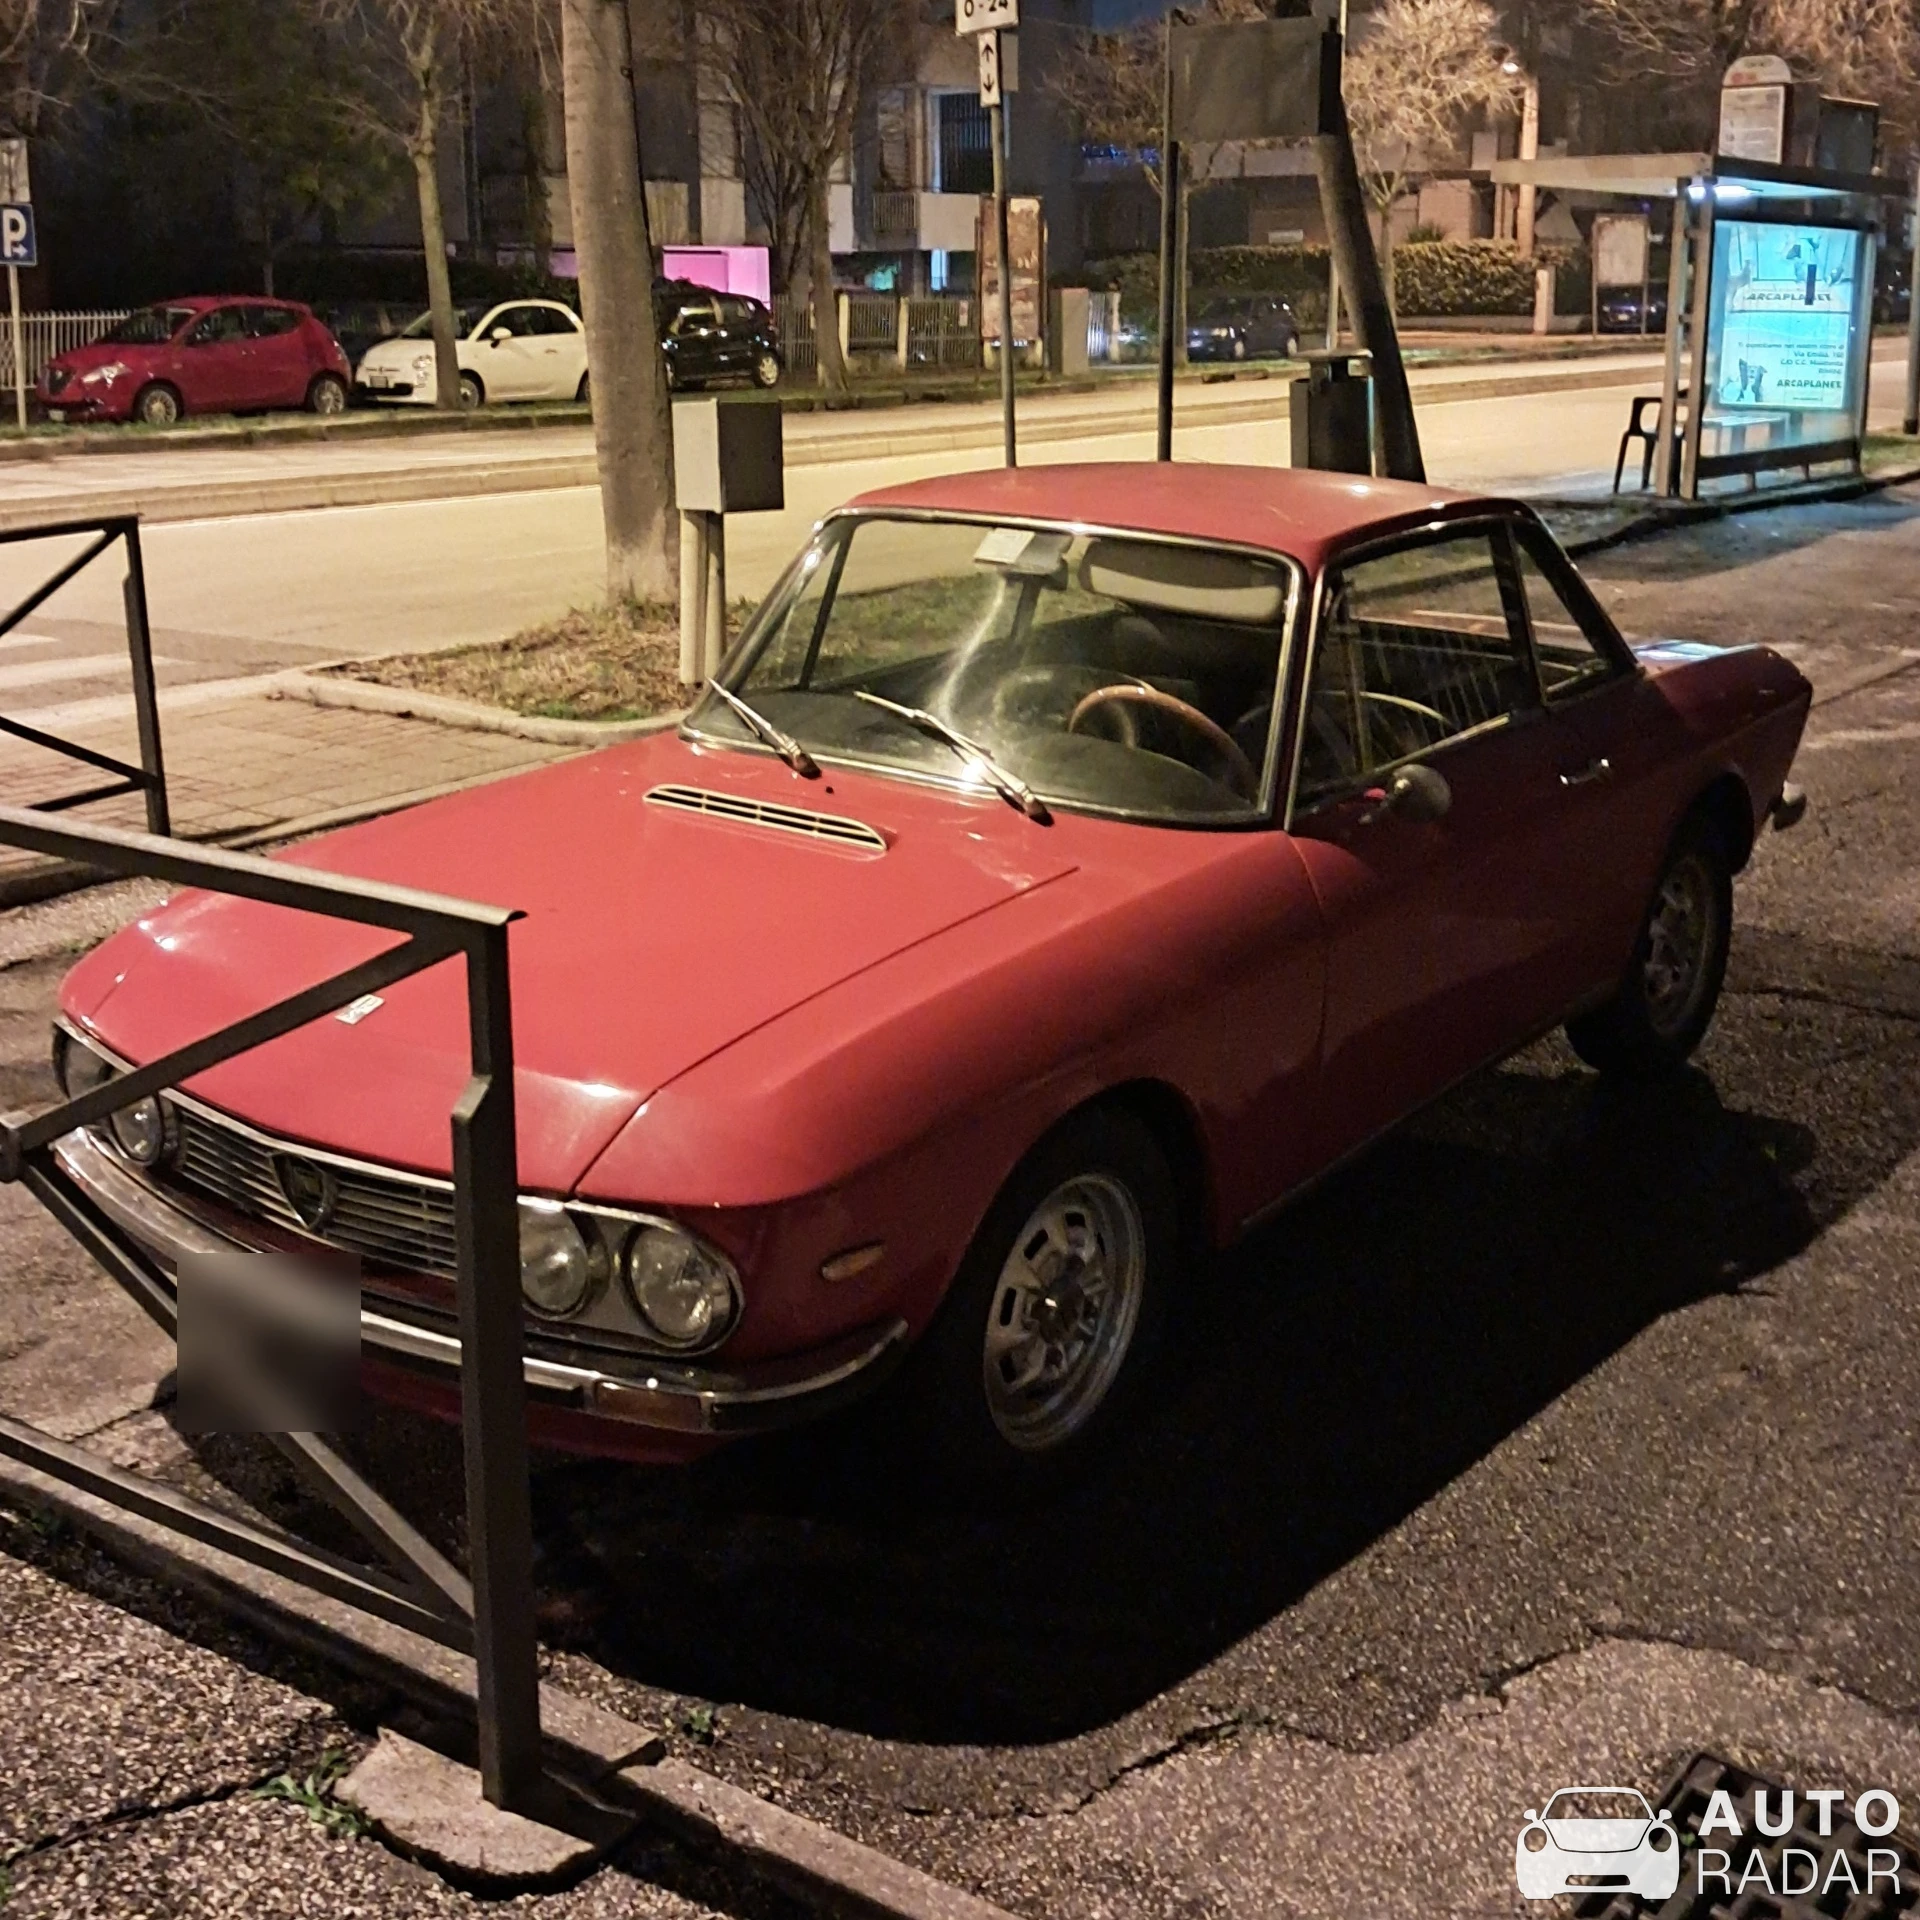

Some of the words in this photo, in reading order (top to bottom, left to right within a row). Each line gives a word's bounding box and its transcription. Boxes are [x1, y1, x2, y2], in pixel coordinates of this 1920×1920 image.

[2, 208, 27, 258] P
[1745, 292, 1832, 302] ARCAPLAET
[1776, 379, 1843, 390] ARCAPLANET
